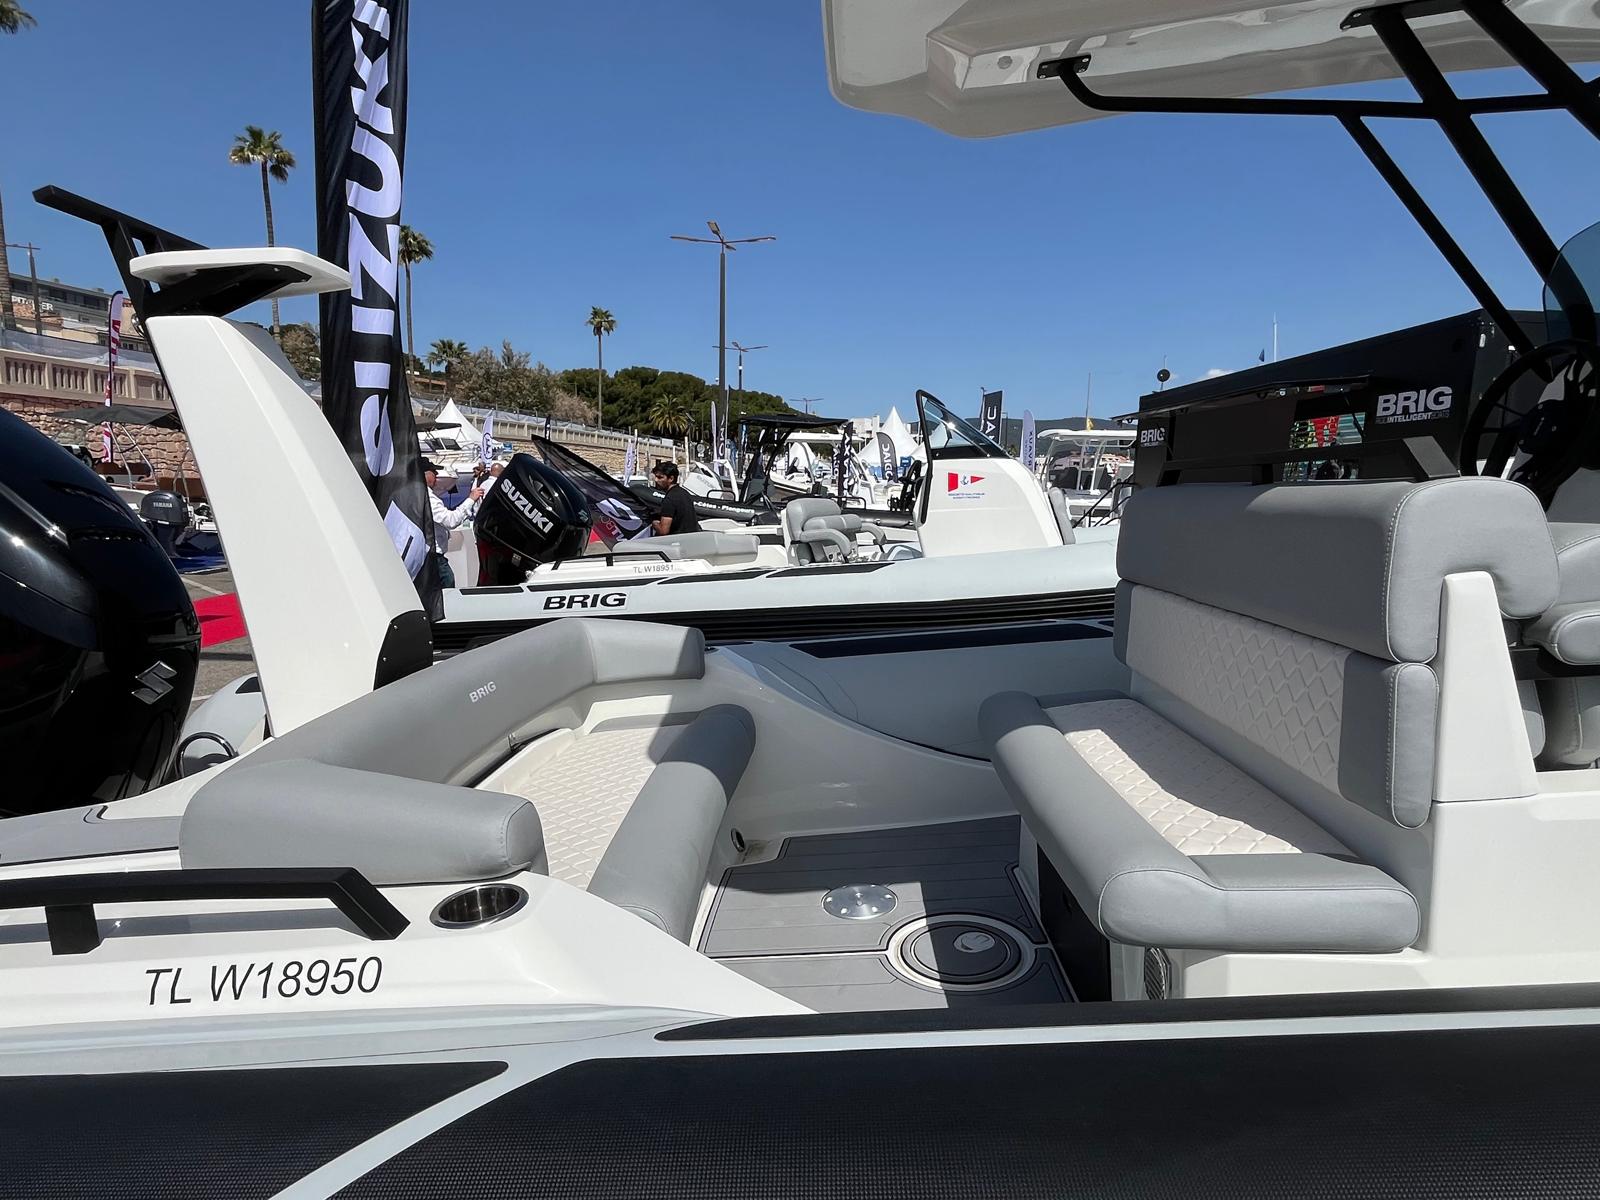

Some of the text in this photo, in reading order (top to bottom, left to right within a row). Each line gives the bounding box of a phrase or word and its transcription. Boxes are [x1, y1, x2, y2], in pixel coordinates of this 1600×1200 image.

[1376, 386, 1453, 417] BRIG
[500, 478, 554, 534] SUZUKI
[543, 592, 627, 610] BRIG
[469, 681, 497, 703] BRIG
[145, 956, 383, 1006] TL W18950
